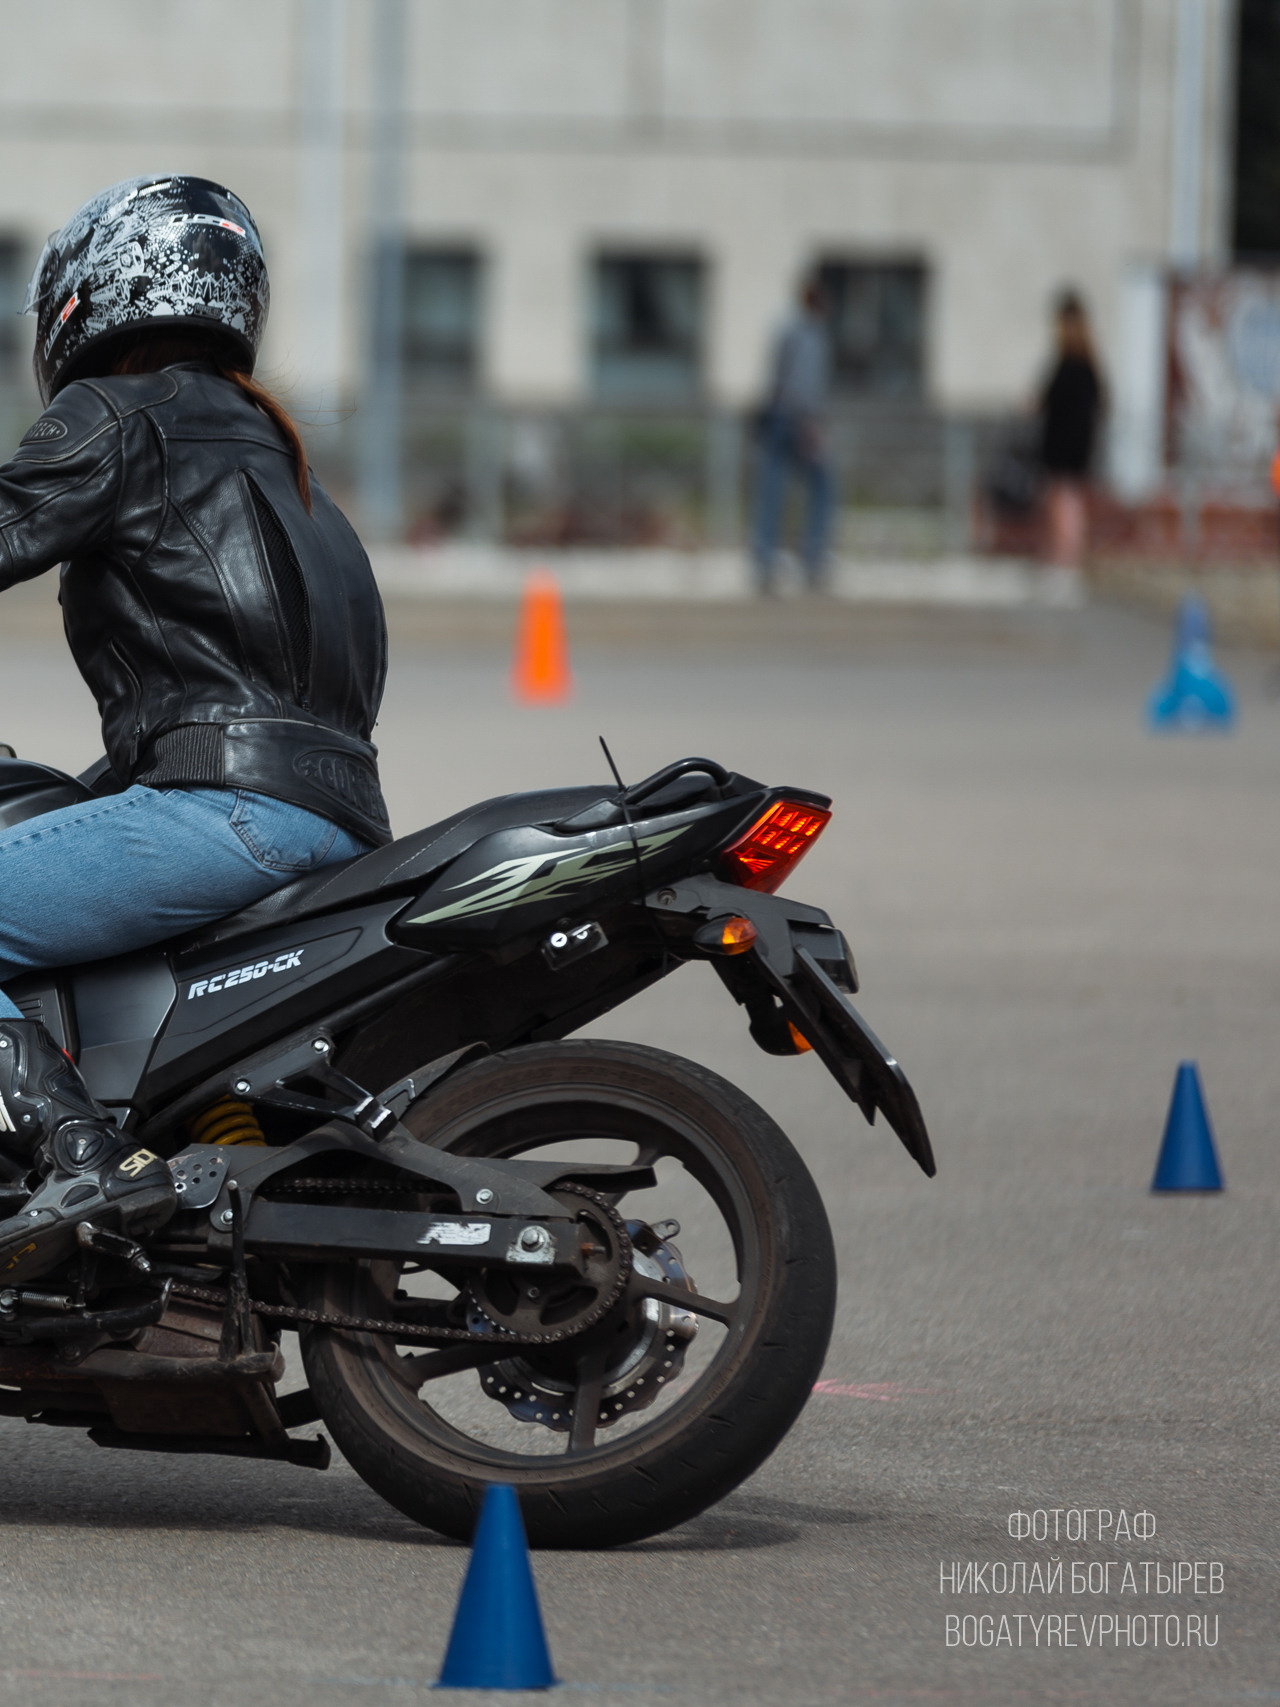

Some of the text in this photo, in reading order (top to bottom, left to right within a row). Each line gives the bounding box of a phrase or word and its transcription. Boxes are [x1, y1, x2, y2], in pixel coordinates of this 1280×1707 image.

[44, 291, 81, 361] LS2
[187, 949, 304, 1000] RC250-CK
[120, 1148, 157, 1178] SIDI
